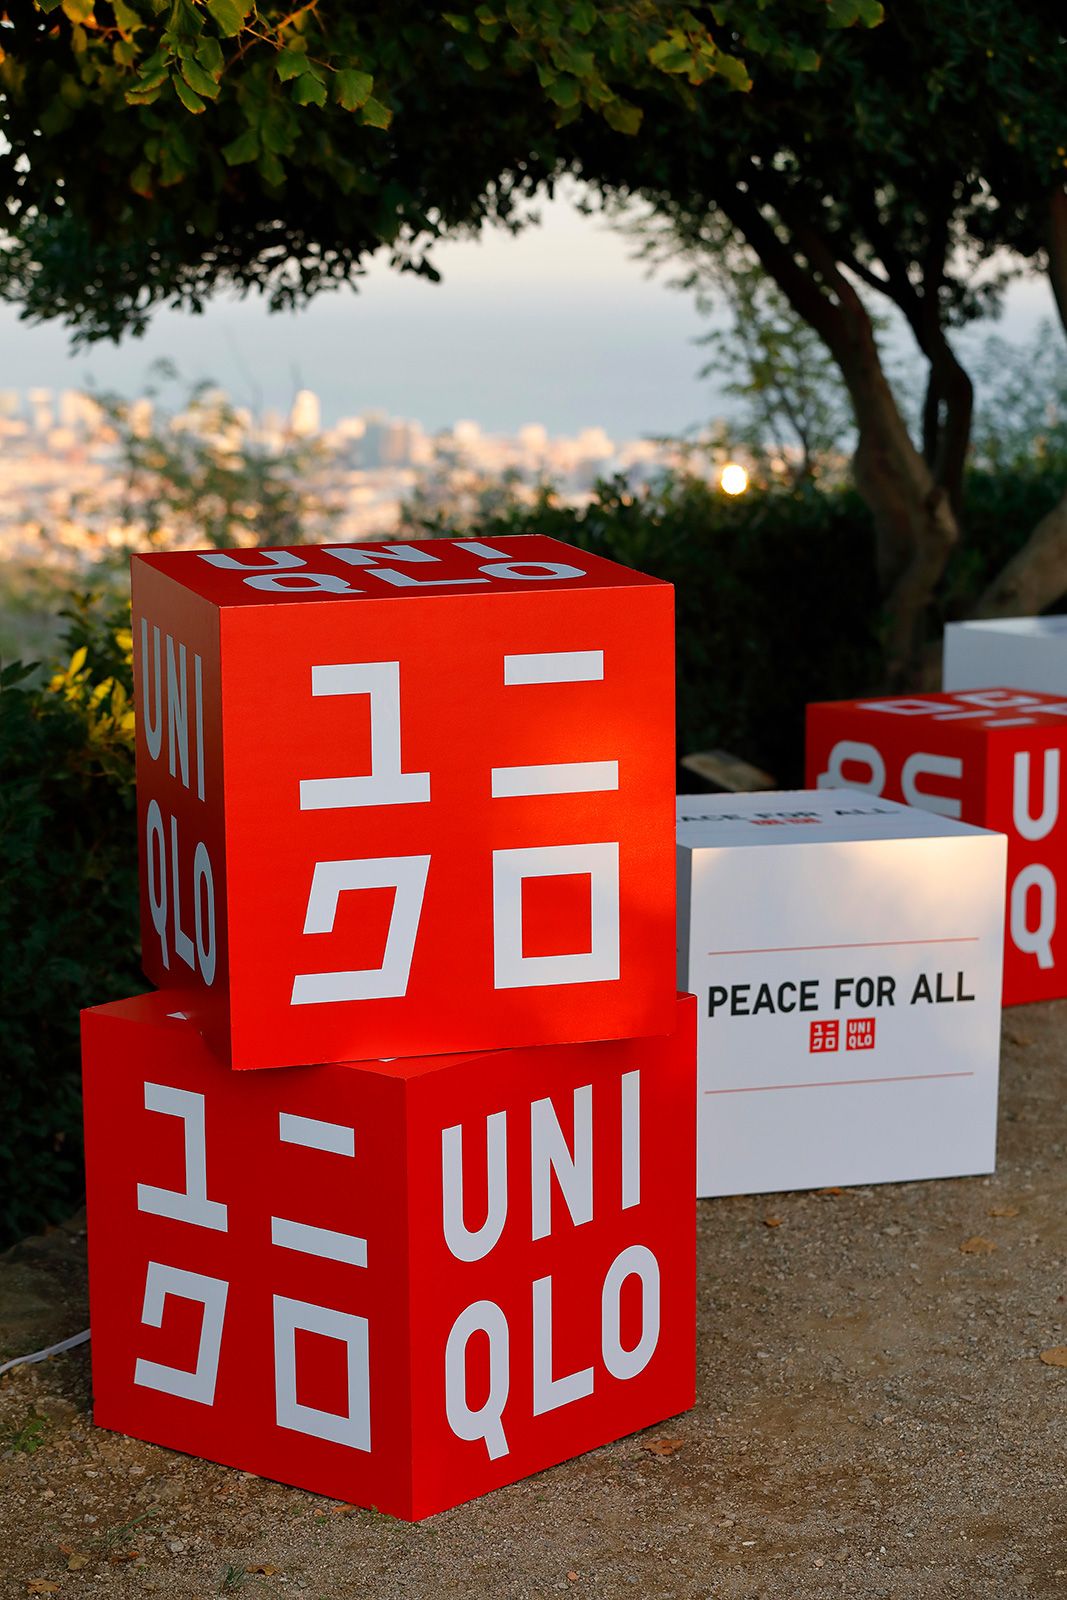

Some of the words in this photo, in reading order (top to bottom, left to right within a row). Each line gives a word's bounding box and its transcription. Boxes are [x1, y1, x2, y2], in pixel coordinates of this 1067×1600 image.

[197, 541, 513, 570] UNI
[242, 562, 587, 594] QLO
[141, 617, 205, 802] UNI
[300, 650, 619, 811] ユニ
[146, 799, 217, 987] QLO
[291, 842, 620, 1006] クロ
[708, 980, 820, 1018] PEACE
[834, 976, 896, 1010] FOR
[910, 971, 975, 1005] ALL
[848, 1034, 873, 1048] QLO
[849, 1021, 871, 1034] UNI
[137, 1081, 369, 1269] ユニ
[441, 1070, 641, 1263] UNI
[133, 1261, 372, 1453] クロ
[445, 1245, 661, 1461] QLO
